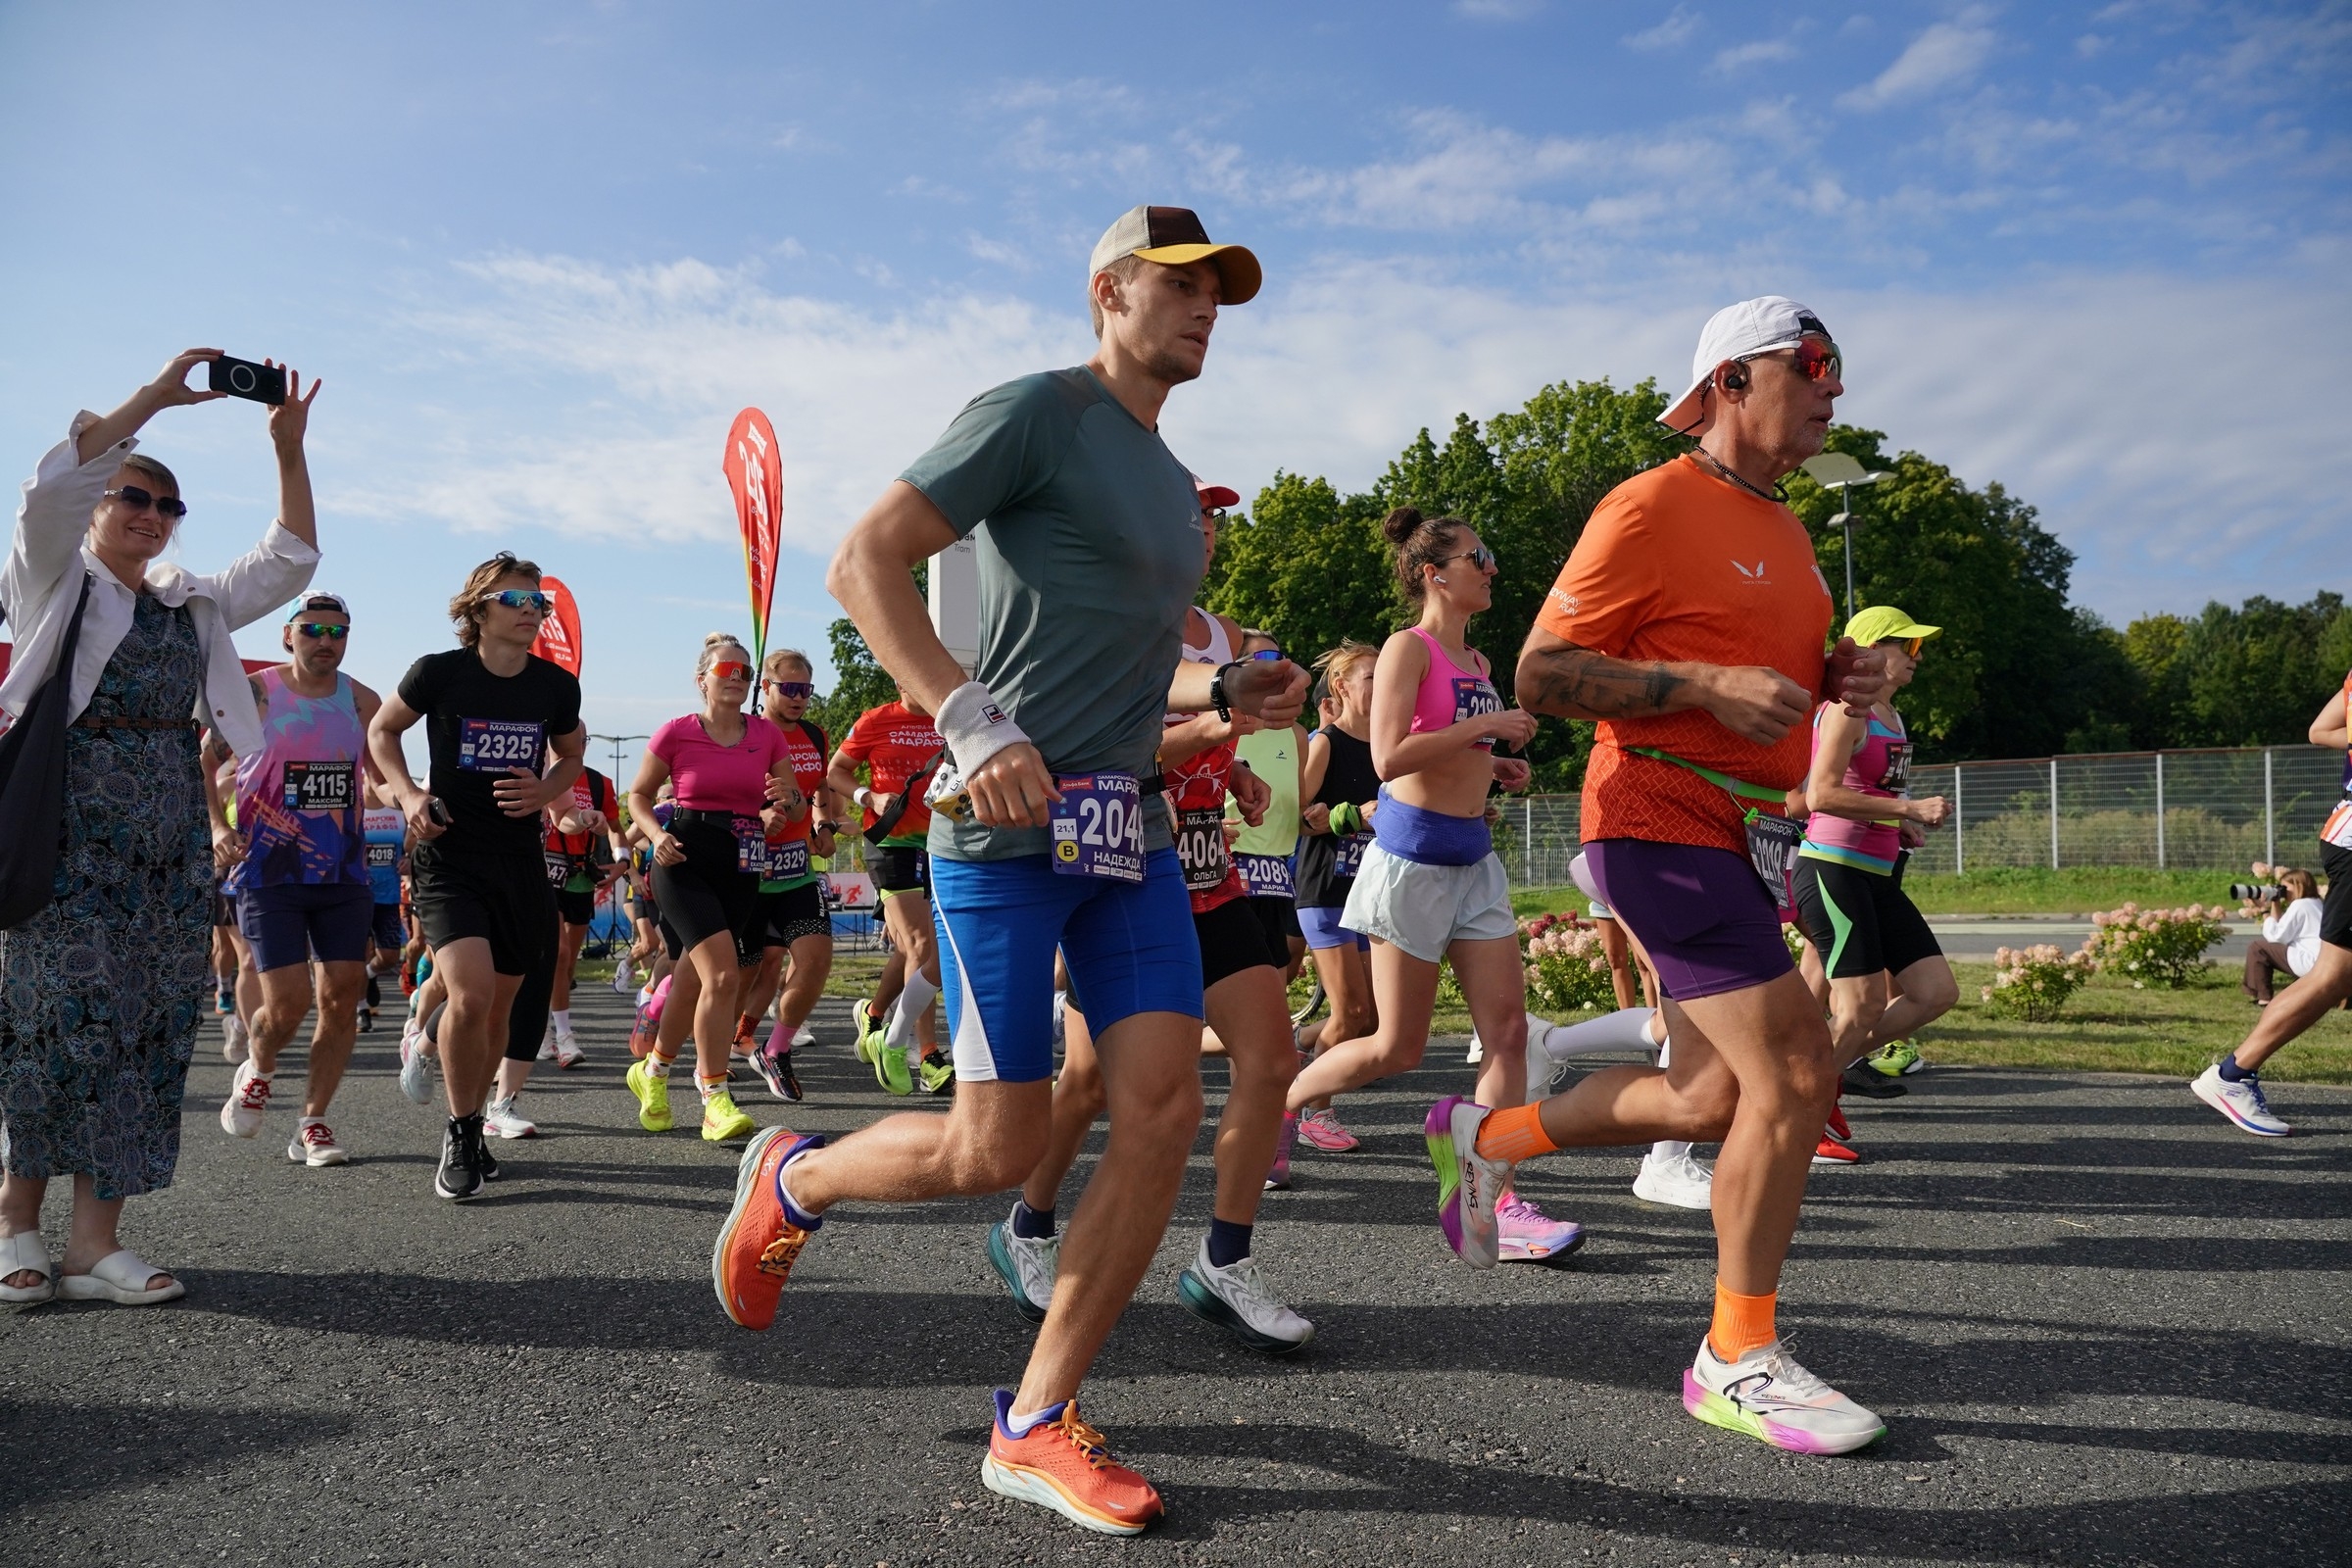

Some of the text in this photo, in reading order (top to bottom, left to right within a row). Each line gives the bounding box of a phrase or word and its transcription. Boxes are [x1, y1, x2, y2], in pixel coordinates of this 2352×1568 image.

[955, 544, 970, 553] Tram
[1559, 603, 1578, 616] RUN
[489, 724, 538, 733] МАРАФОН
[477, 733, 533, 760] 2325
[302, 774, 347, 797] 4115
[1098, 780, 1140, 796] МАРА
[1056, 825, 1075, 834] 21,1
[1079, 797, 1144, 856] 2048
[1759, 820, 1793, 837] МАРАФОН
[368, 849, 394, 860] 4018
[1176, 830, 1225, 869] 4064
[773, 850, 806, 871] 2329
[1094, 851, 1141, 871] НАДЕЖДА
[1194, 870, 1217, 881] ОЛЬГА
[1248, 858, 1290, 885] 2089
[760, 1141, 788, 1177] HOKA
